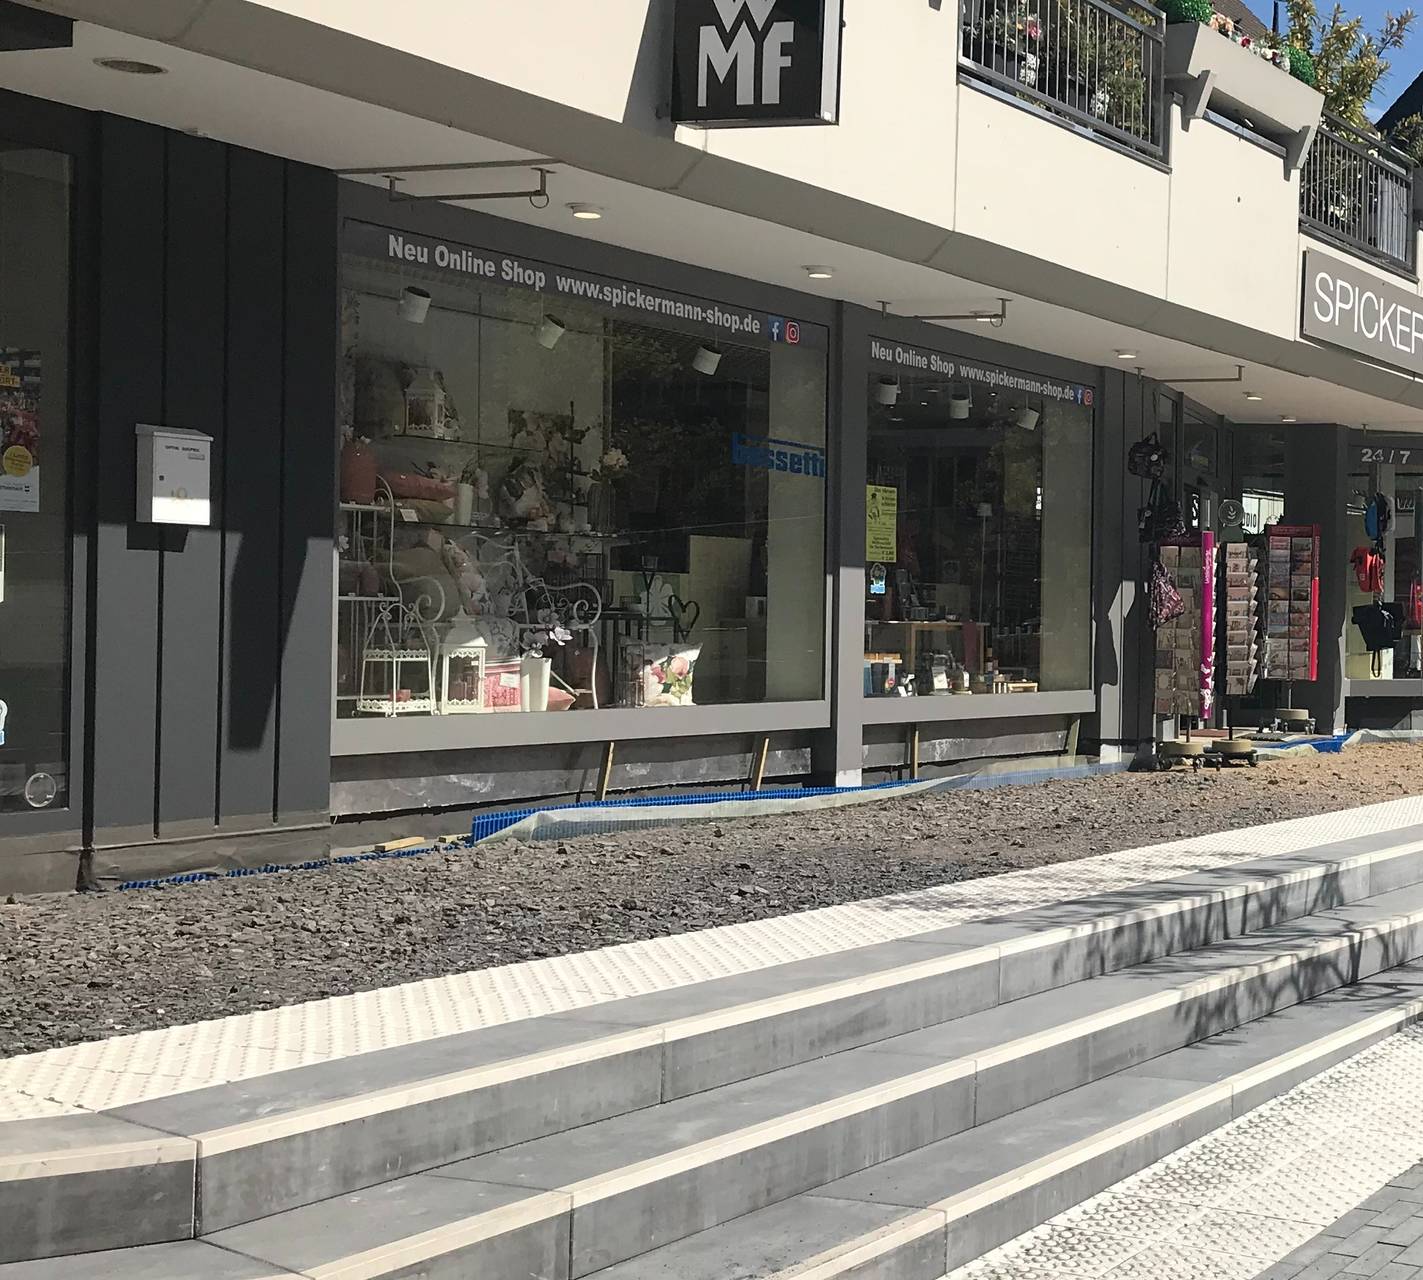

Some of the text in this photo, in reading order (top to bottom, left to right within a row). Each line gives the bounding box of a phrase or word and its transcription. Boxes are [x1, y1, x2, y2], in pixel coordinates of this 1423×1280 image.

[388, 234, 428, 263] Neu
[435, 245, 496, 277] Online
[501, 259, 546, 291] Shop
[556, 275, 760, 334] www.spickermann-shop.de
[871, 341, 892, 361] Neu
[895, 346, 928, 369] Online
[930, 355, 954, 378] Shop
[960, 364, 1074, 401] www.spickermann-shop.de
[731, 432, 824, 478] bssetti
